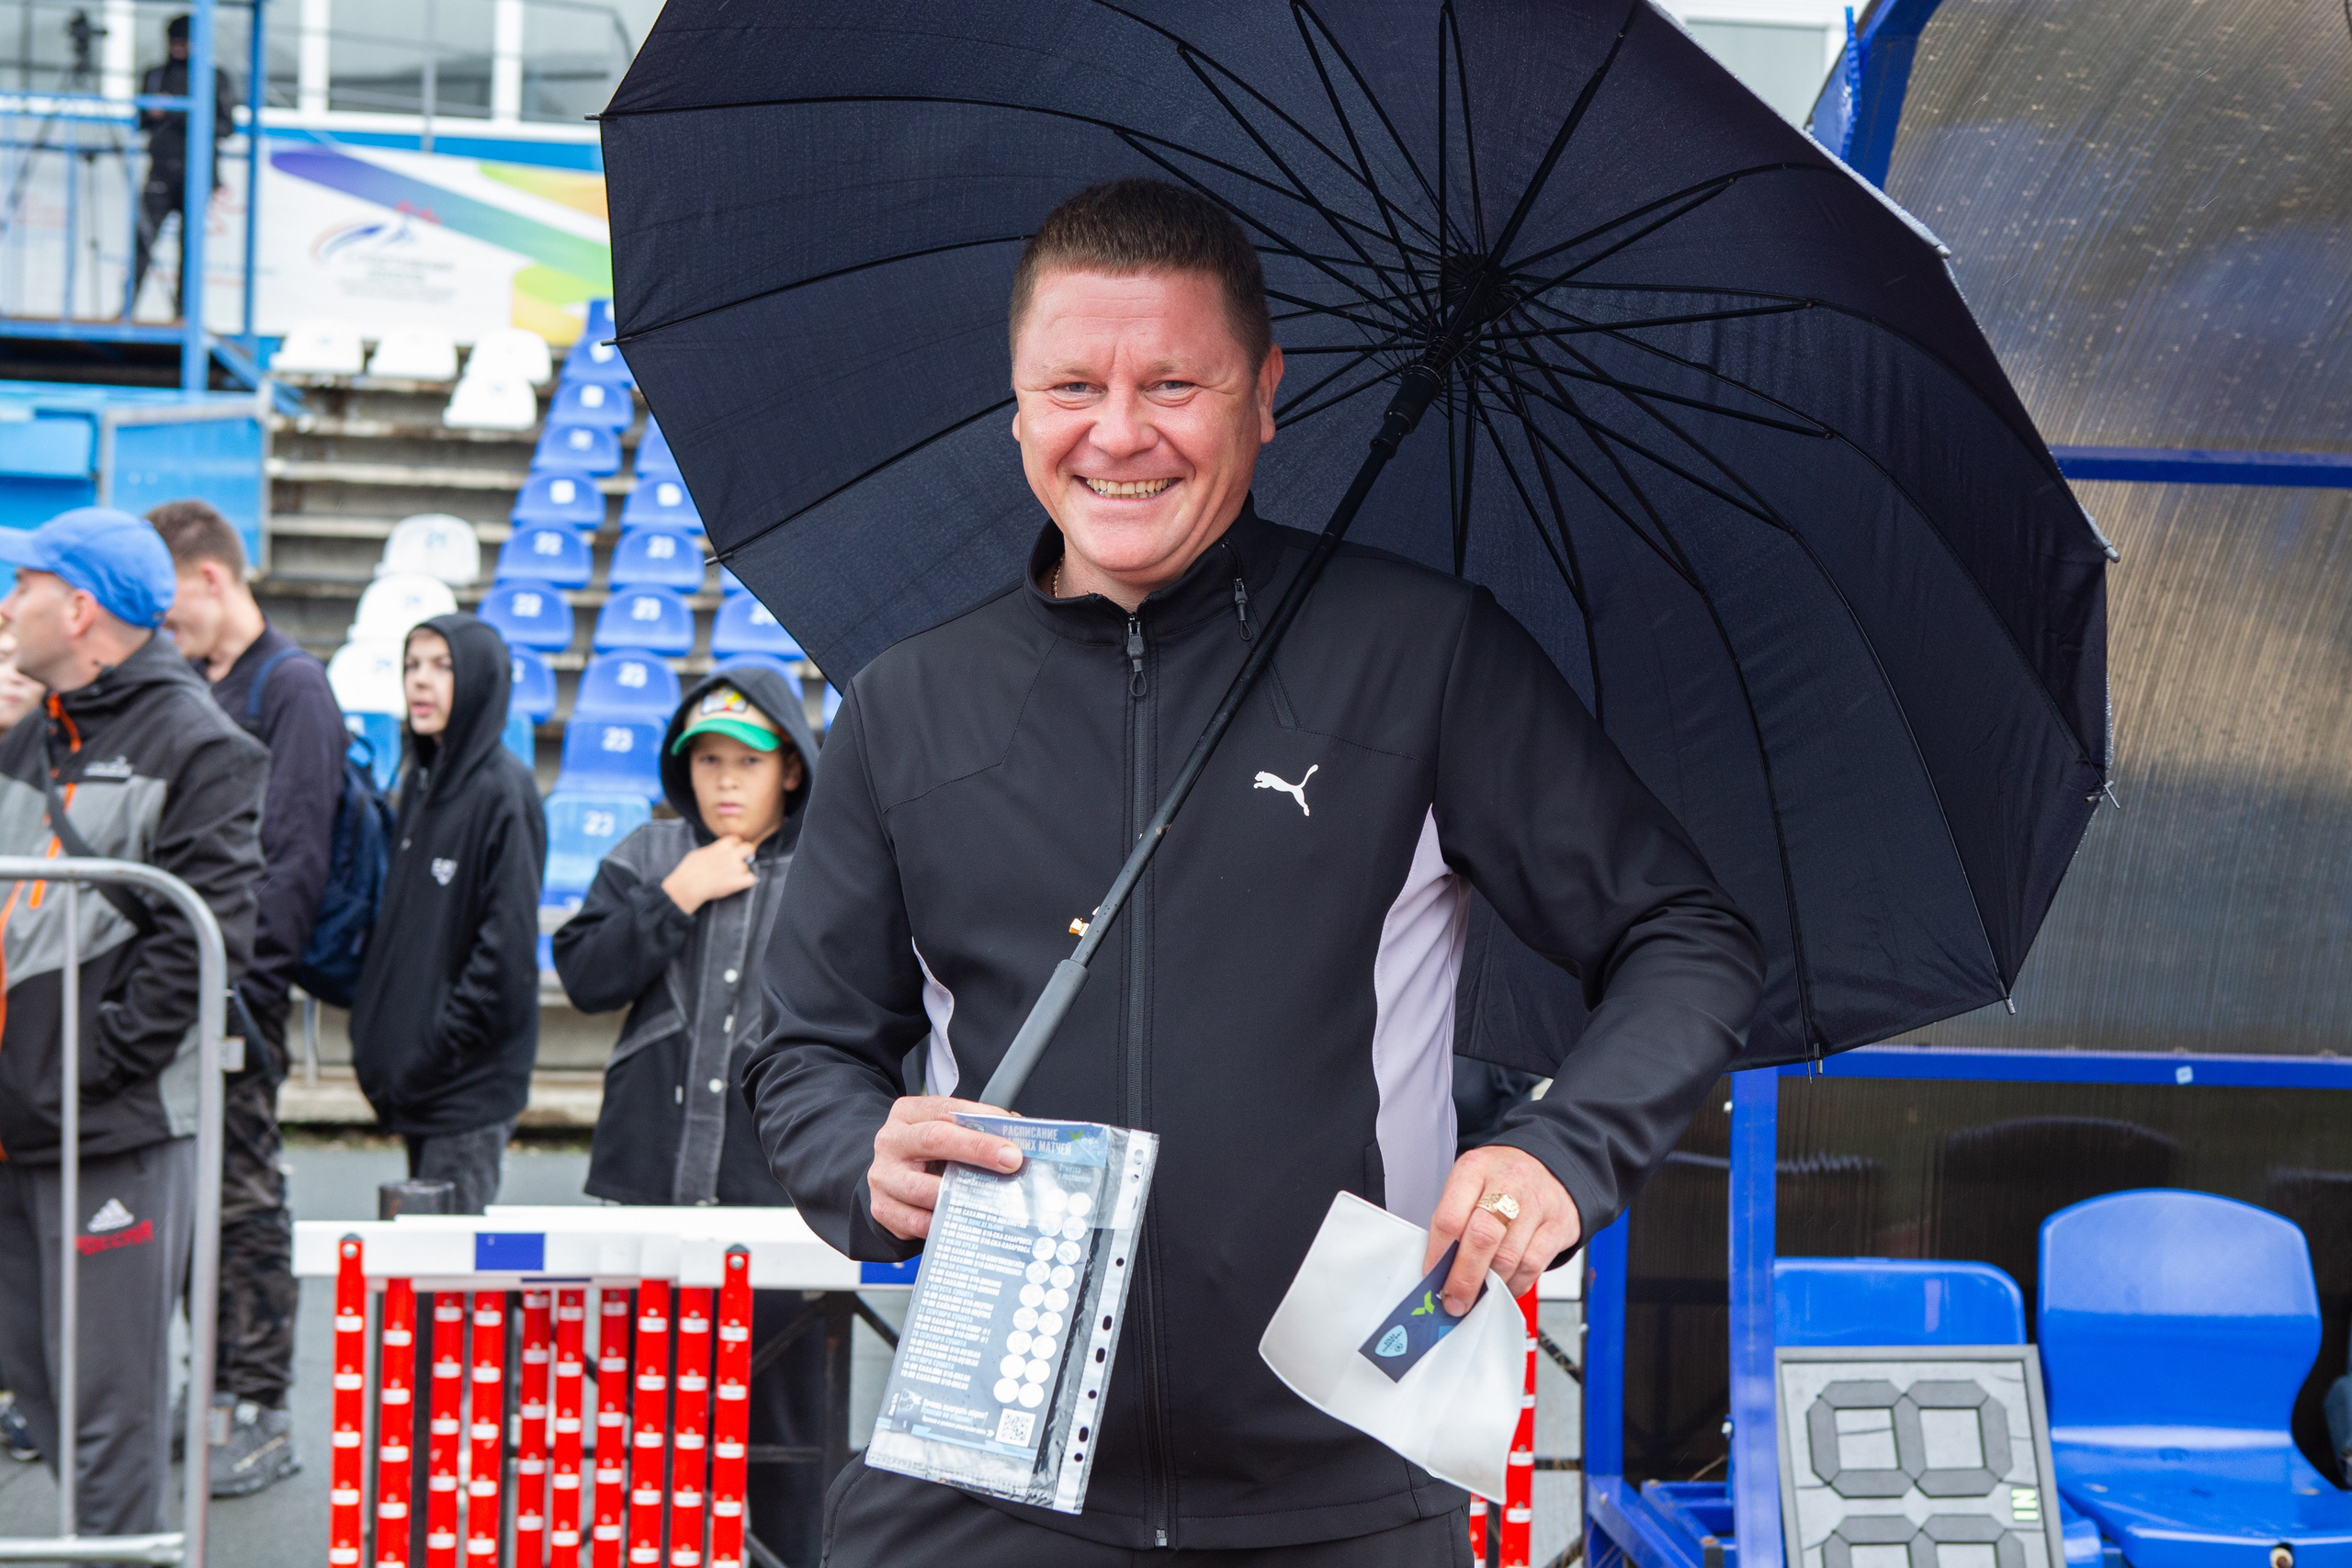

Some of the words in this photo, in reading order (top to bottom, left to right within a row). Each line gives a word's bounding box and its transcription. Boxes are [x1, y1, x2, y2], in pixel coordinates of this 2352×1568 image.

[603, 726, 634, 752] 23
[583, 810, 615, 838] 23
[1002, 1124, 1058, 1141] РАСПИСАНИЕ
[1038, 1141, 1072, 1156] МАТЧЕЙ
[2010, 1488, 2039, 1522] IN
